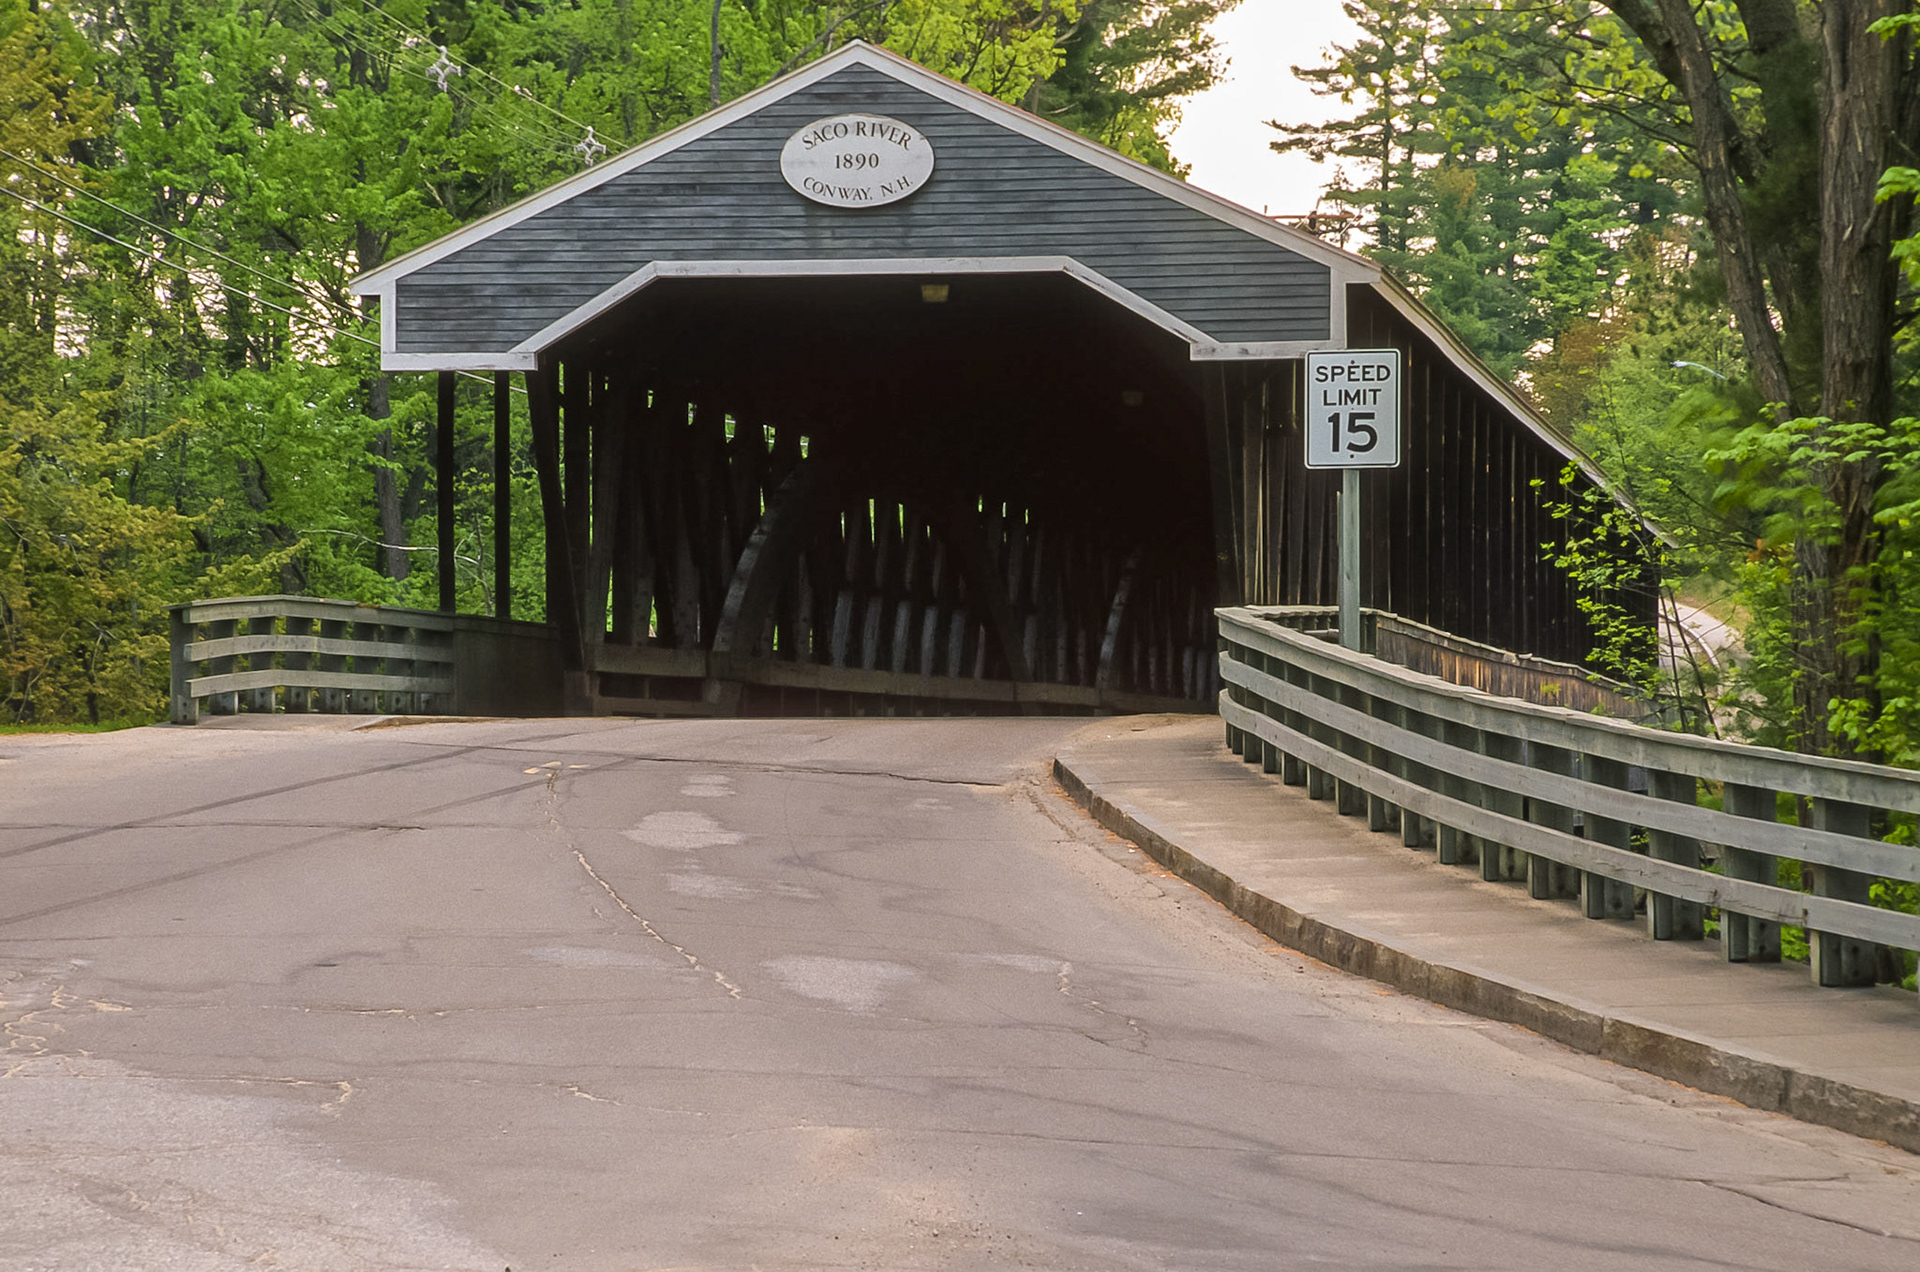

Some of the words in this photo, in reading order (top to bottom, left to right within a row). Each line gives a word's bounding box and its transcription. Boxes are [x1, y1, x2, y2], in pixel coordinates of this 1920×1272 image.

[802, 122, 848, 150] SACO
[856, 121, 912, 150] RIVER
[835, 153, 880, 170] 1890
[1315, 365, 1391, 382] SPEED
[1323, 388, 1381, 406] LIMIT
[1328, 412, 1377, 452] 15
